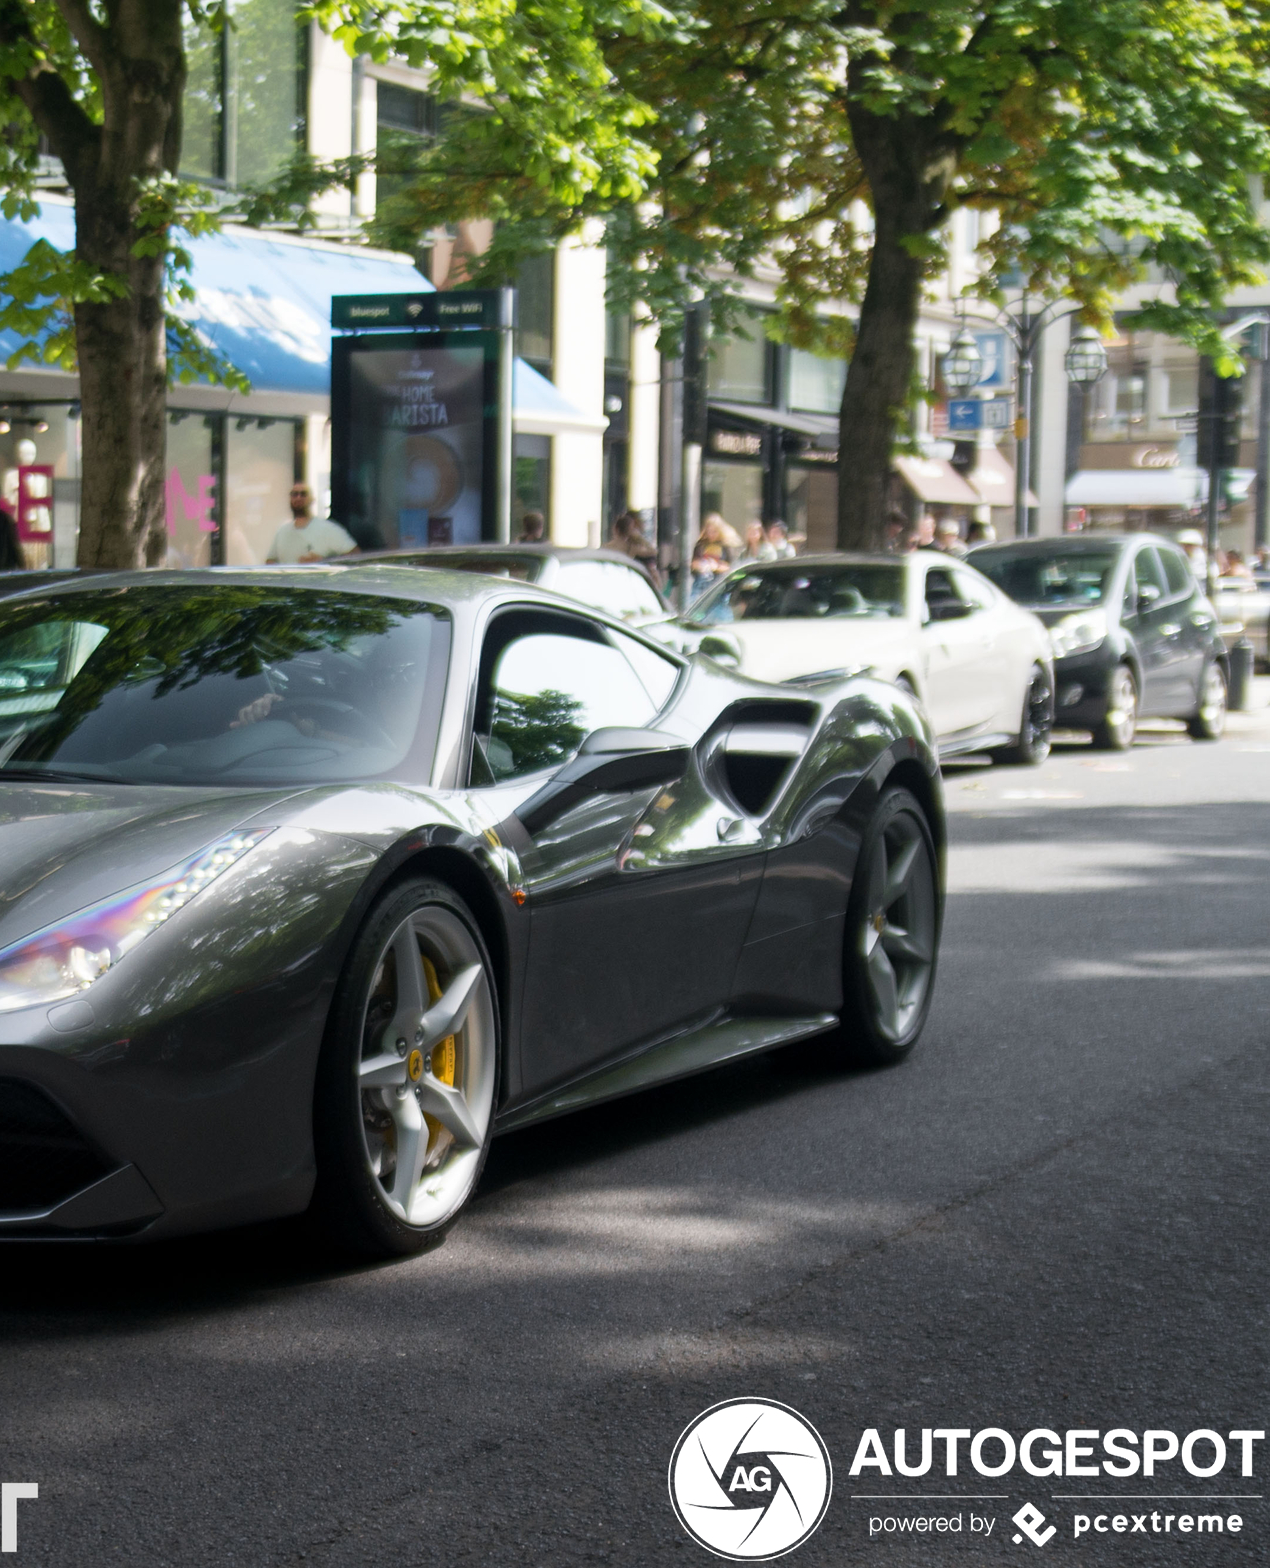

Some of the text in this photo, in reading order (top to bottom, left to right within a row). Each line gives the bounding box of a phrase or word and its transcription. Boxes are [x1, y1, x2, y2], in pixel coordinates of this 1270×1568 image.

[350, 303, 483, 318] bluespot Free WiFi
[402, 384, 436, 403] HOME
